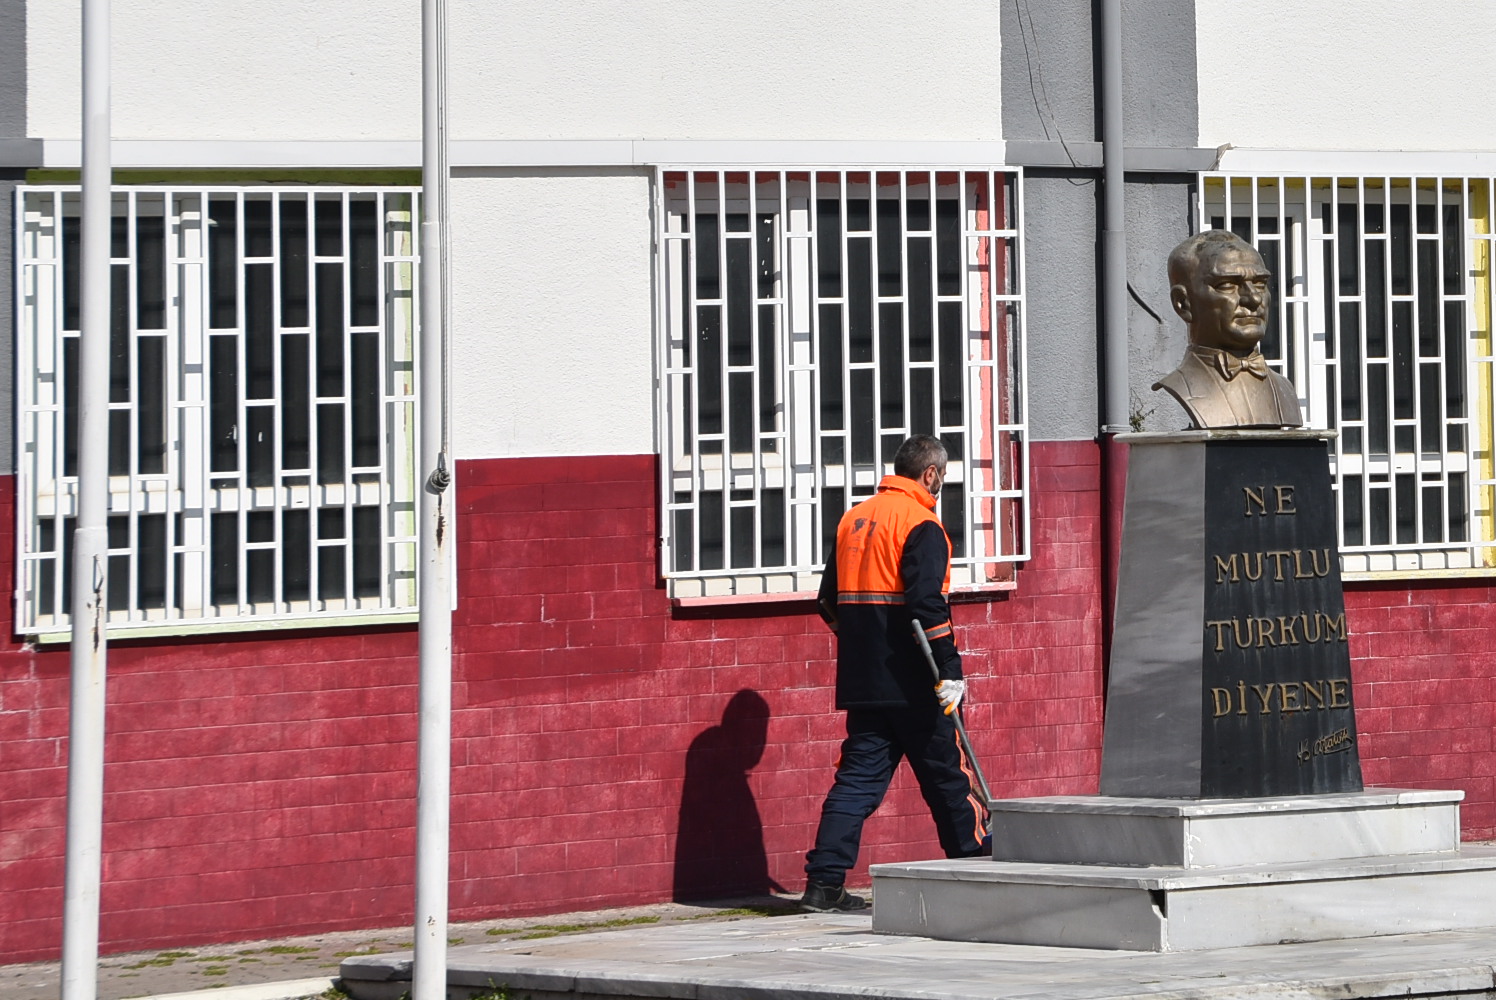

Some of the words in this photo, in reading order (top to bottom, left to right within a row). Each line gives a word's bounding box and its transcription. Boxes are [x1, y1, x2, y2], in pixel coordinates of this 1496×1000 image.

[1243, 485, 1297, 516] NE
[1213, 548, 1331, 584] MUTLU
[1205, 609, 1348, 652] TÜRKÜM
[1211, 678, 1350, 717] DİYENE
